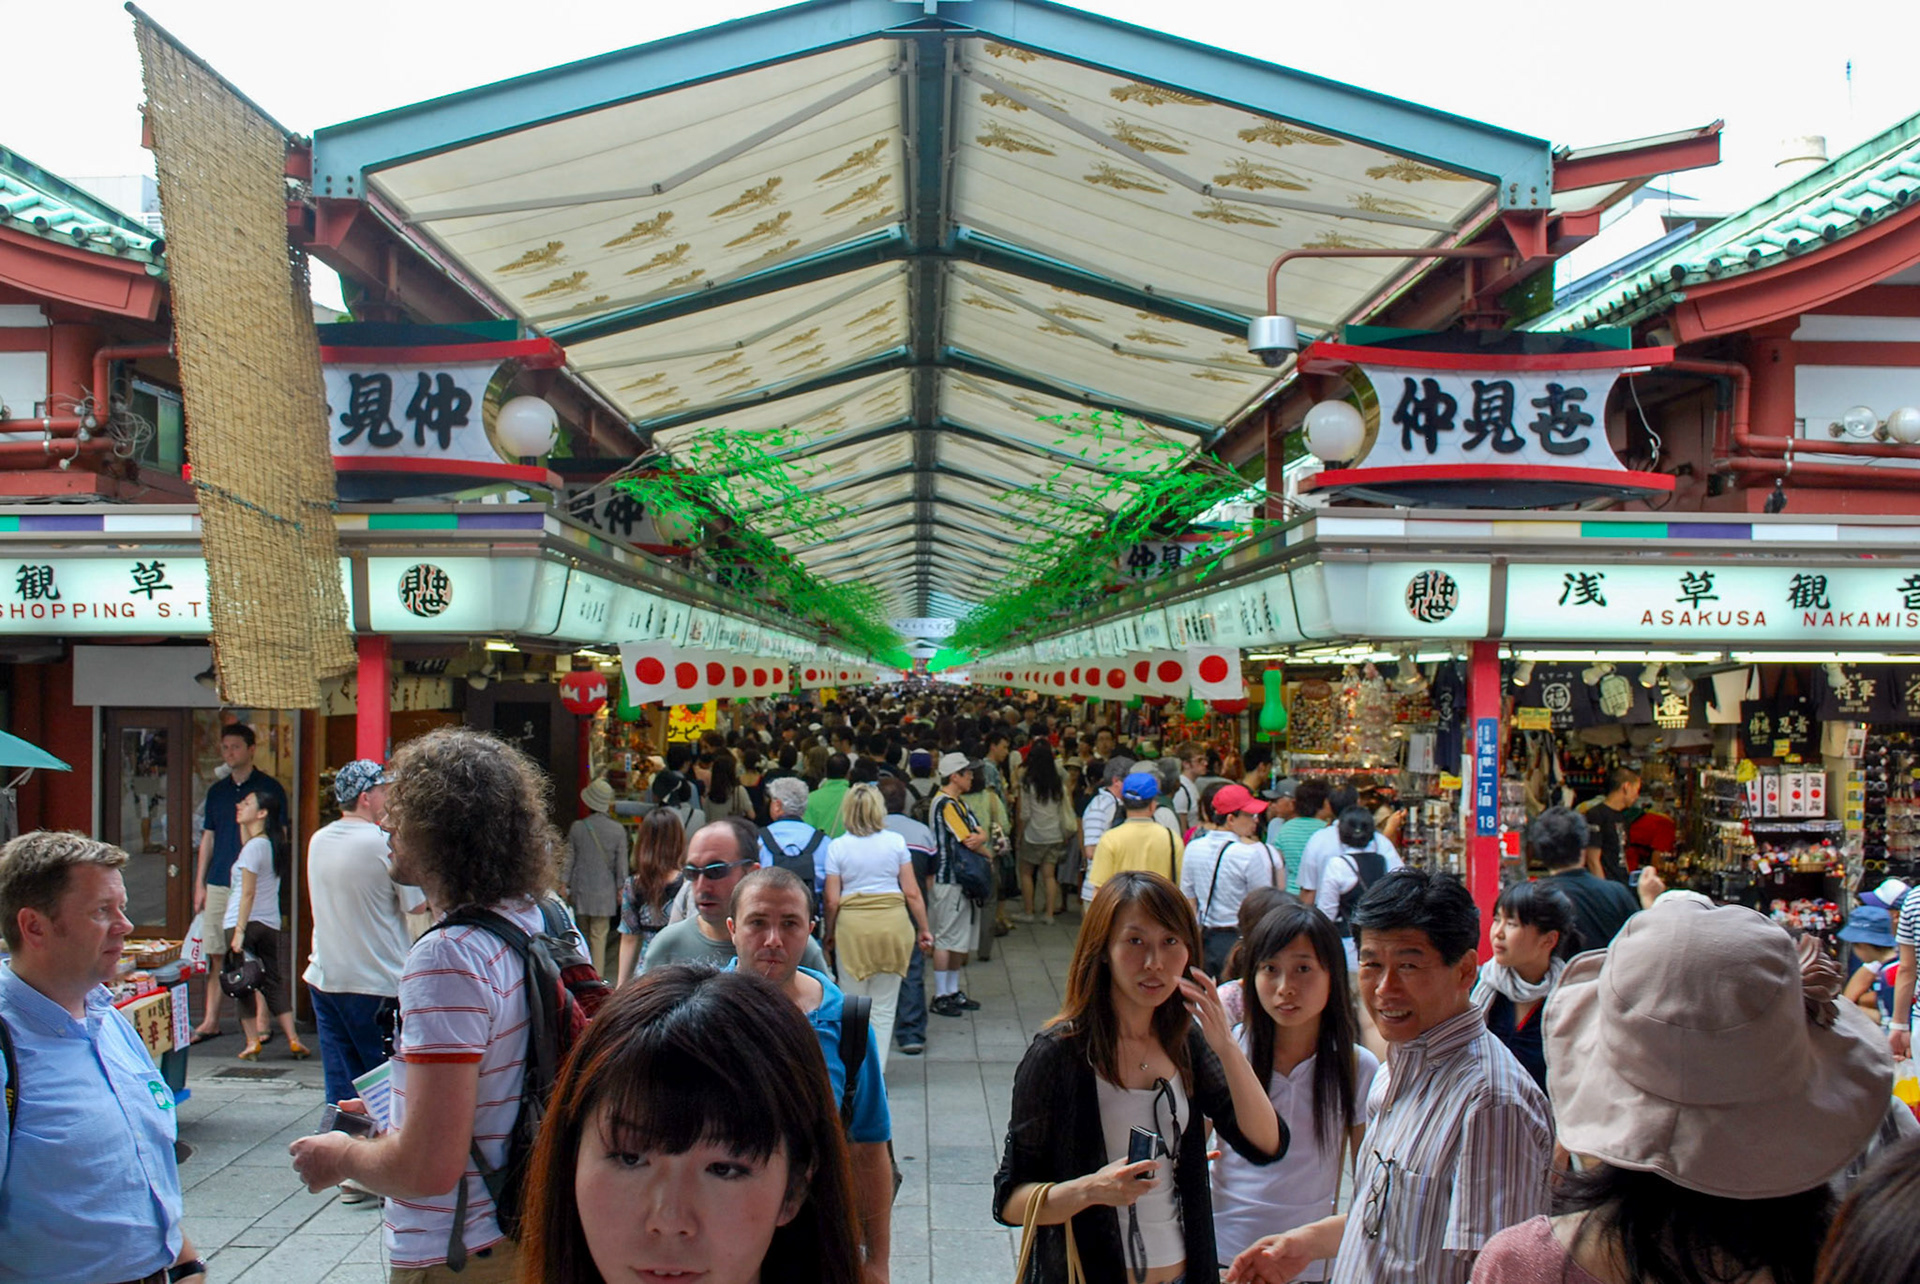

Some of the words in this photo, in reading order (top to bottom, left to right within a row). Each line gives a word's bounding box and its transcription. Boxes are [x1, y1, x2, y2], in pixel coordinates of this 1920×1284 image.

[1392, 376, 1594, 456] 仲見世
[1641, 610, 1767, 627] ASAKUSA
[1479, 815, 1495, 829] 18
